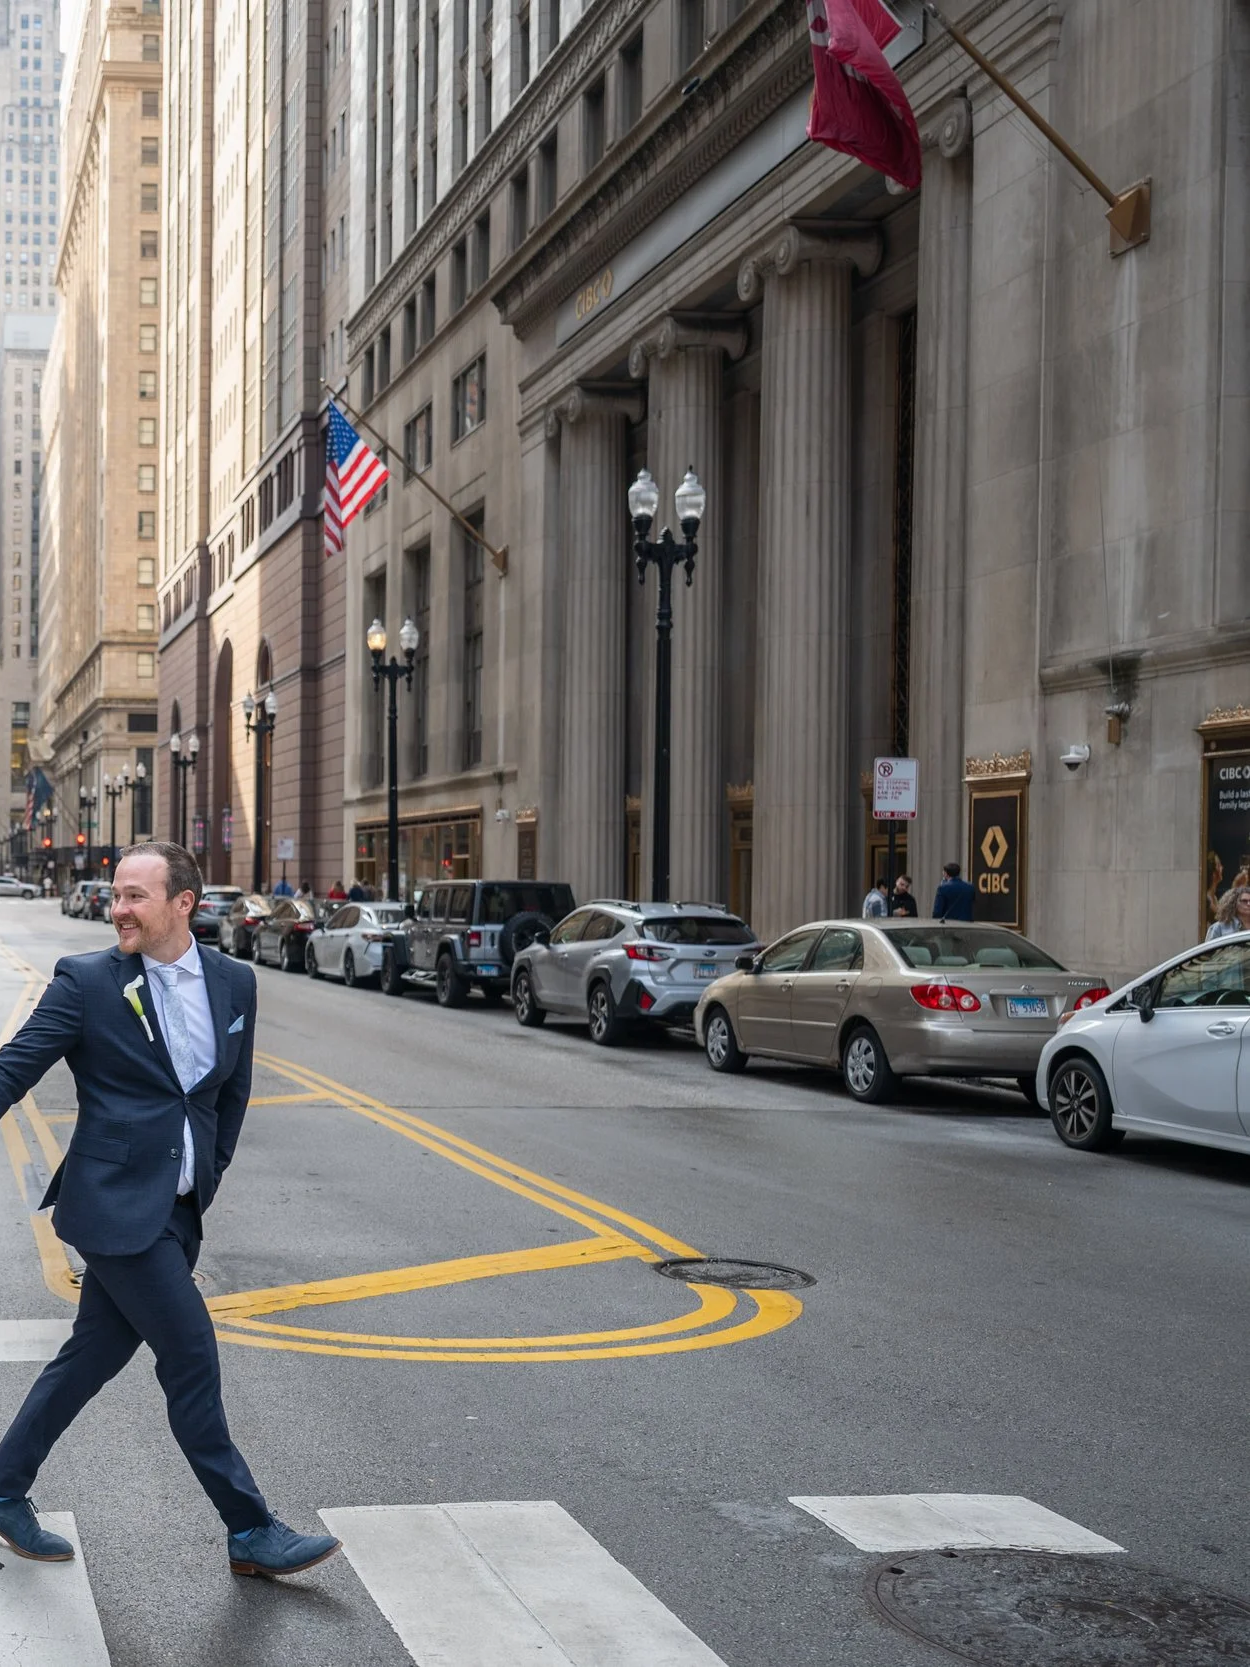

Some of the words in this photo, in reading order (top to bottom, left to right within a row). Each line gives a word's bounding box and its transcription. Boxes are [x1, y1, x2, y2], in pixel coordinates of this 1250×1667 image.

[576, 279, 600, 320] CIBC
[1219, 766, 1242, 780] CIBC
[1219, 790, 1234, 799] Build
[1219, 800, 1237, 811] family
[979, 873, 1009, 893] CIBC
